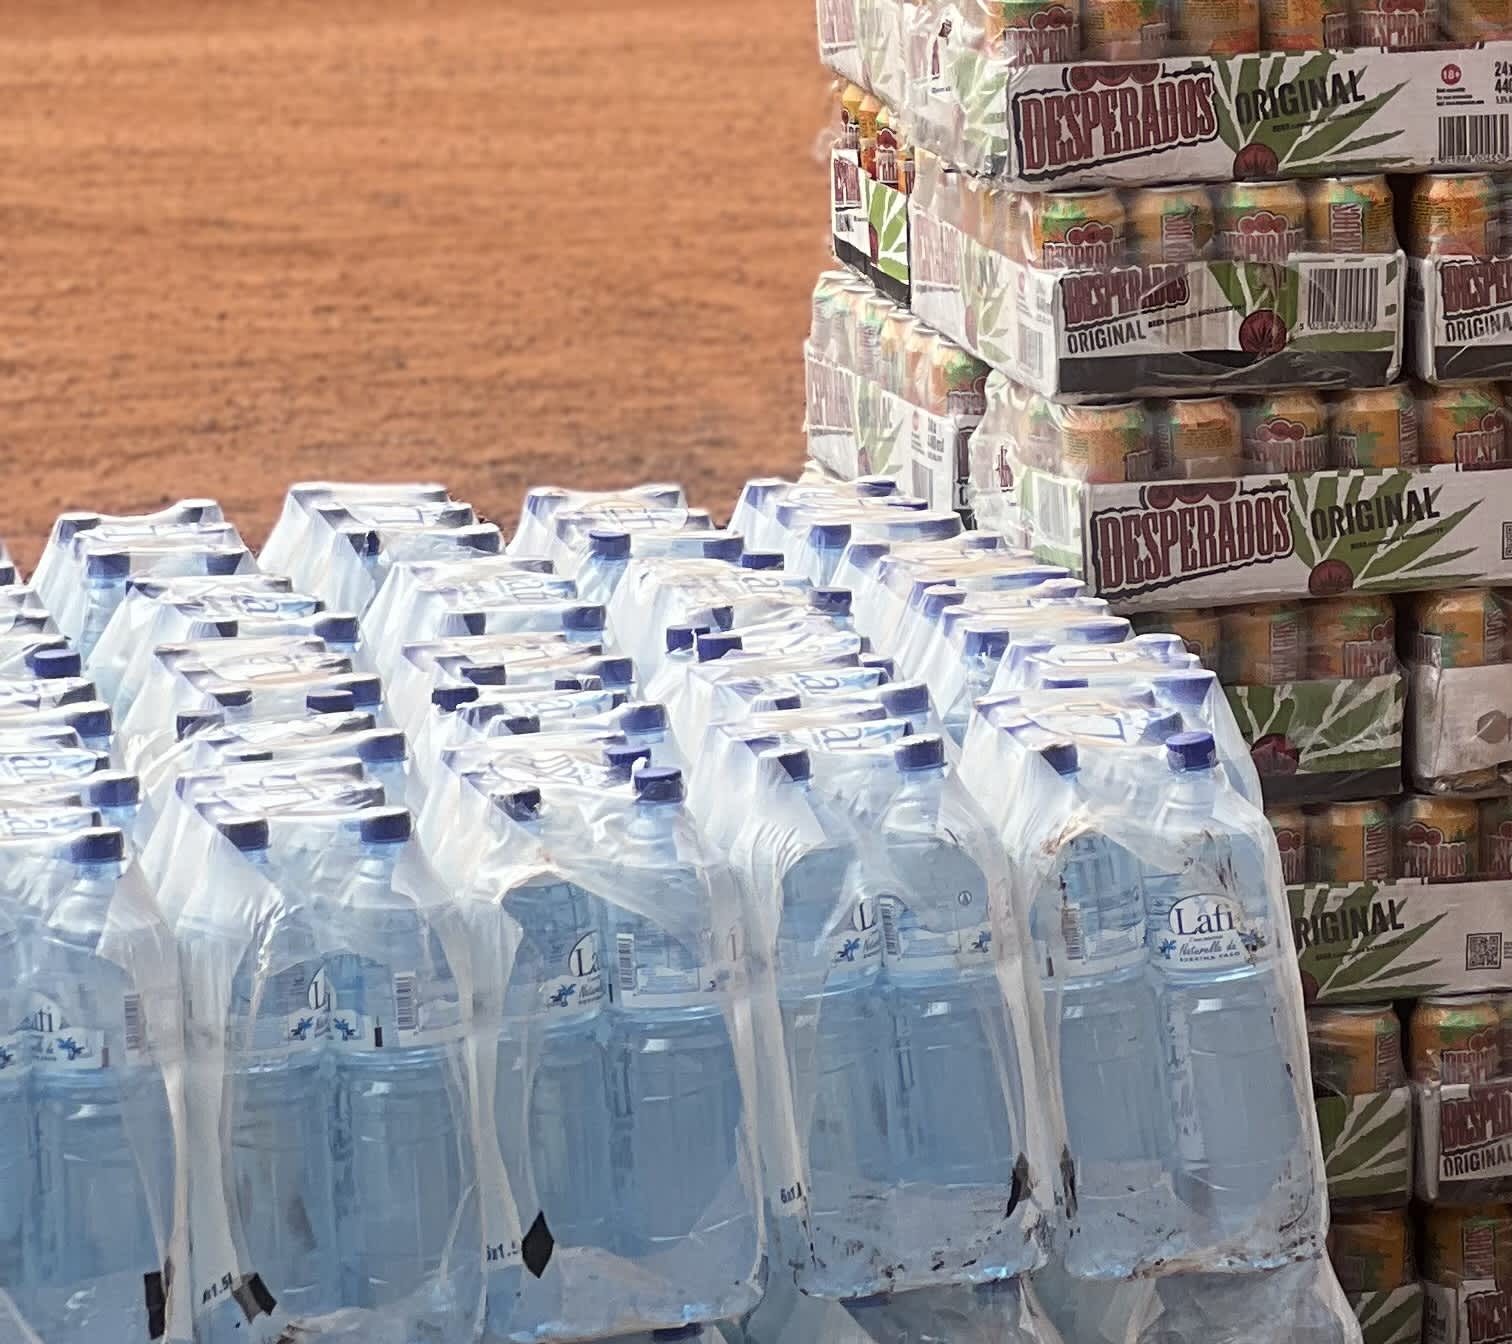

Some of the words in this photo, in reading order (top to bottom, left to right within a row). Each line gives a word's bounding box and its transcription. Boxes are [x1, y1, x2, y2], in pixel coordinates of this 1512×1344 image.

[1022, 78, 1215, 170] DESPERADOS
[1236, 71, 1365, 123] ORIGINAL
[1067, 322, 1146, 353] ORIGINAL
[1099, 492, 1291, 590] DESPERADOS
[1312, 486, 1440, 539] ORIGINAL
[1175, 904, 1235, 936] Lafi
[1293, 900, 1404, 949] RIGINAL
